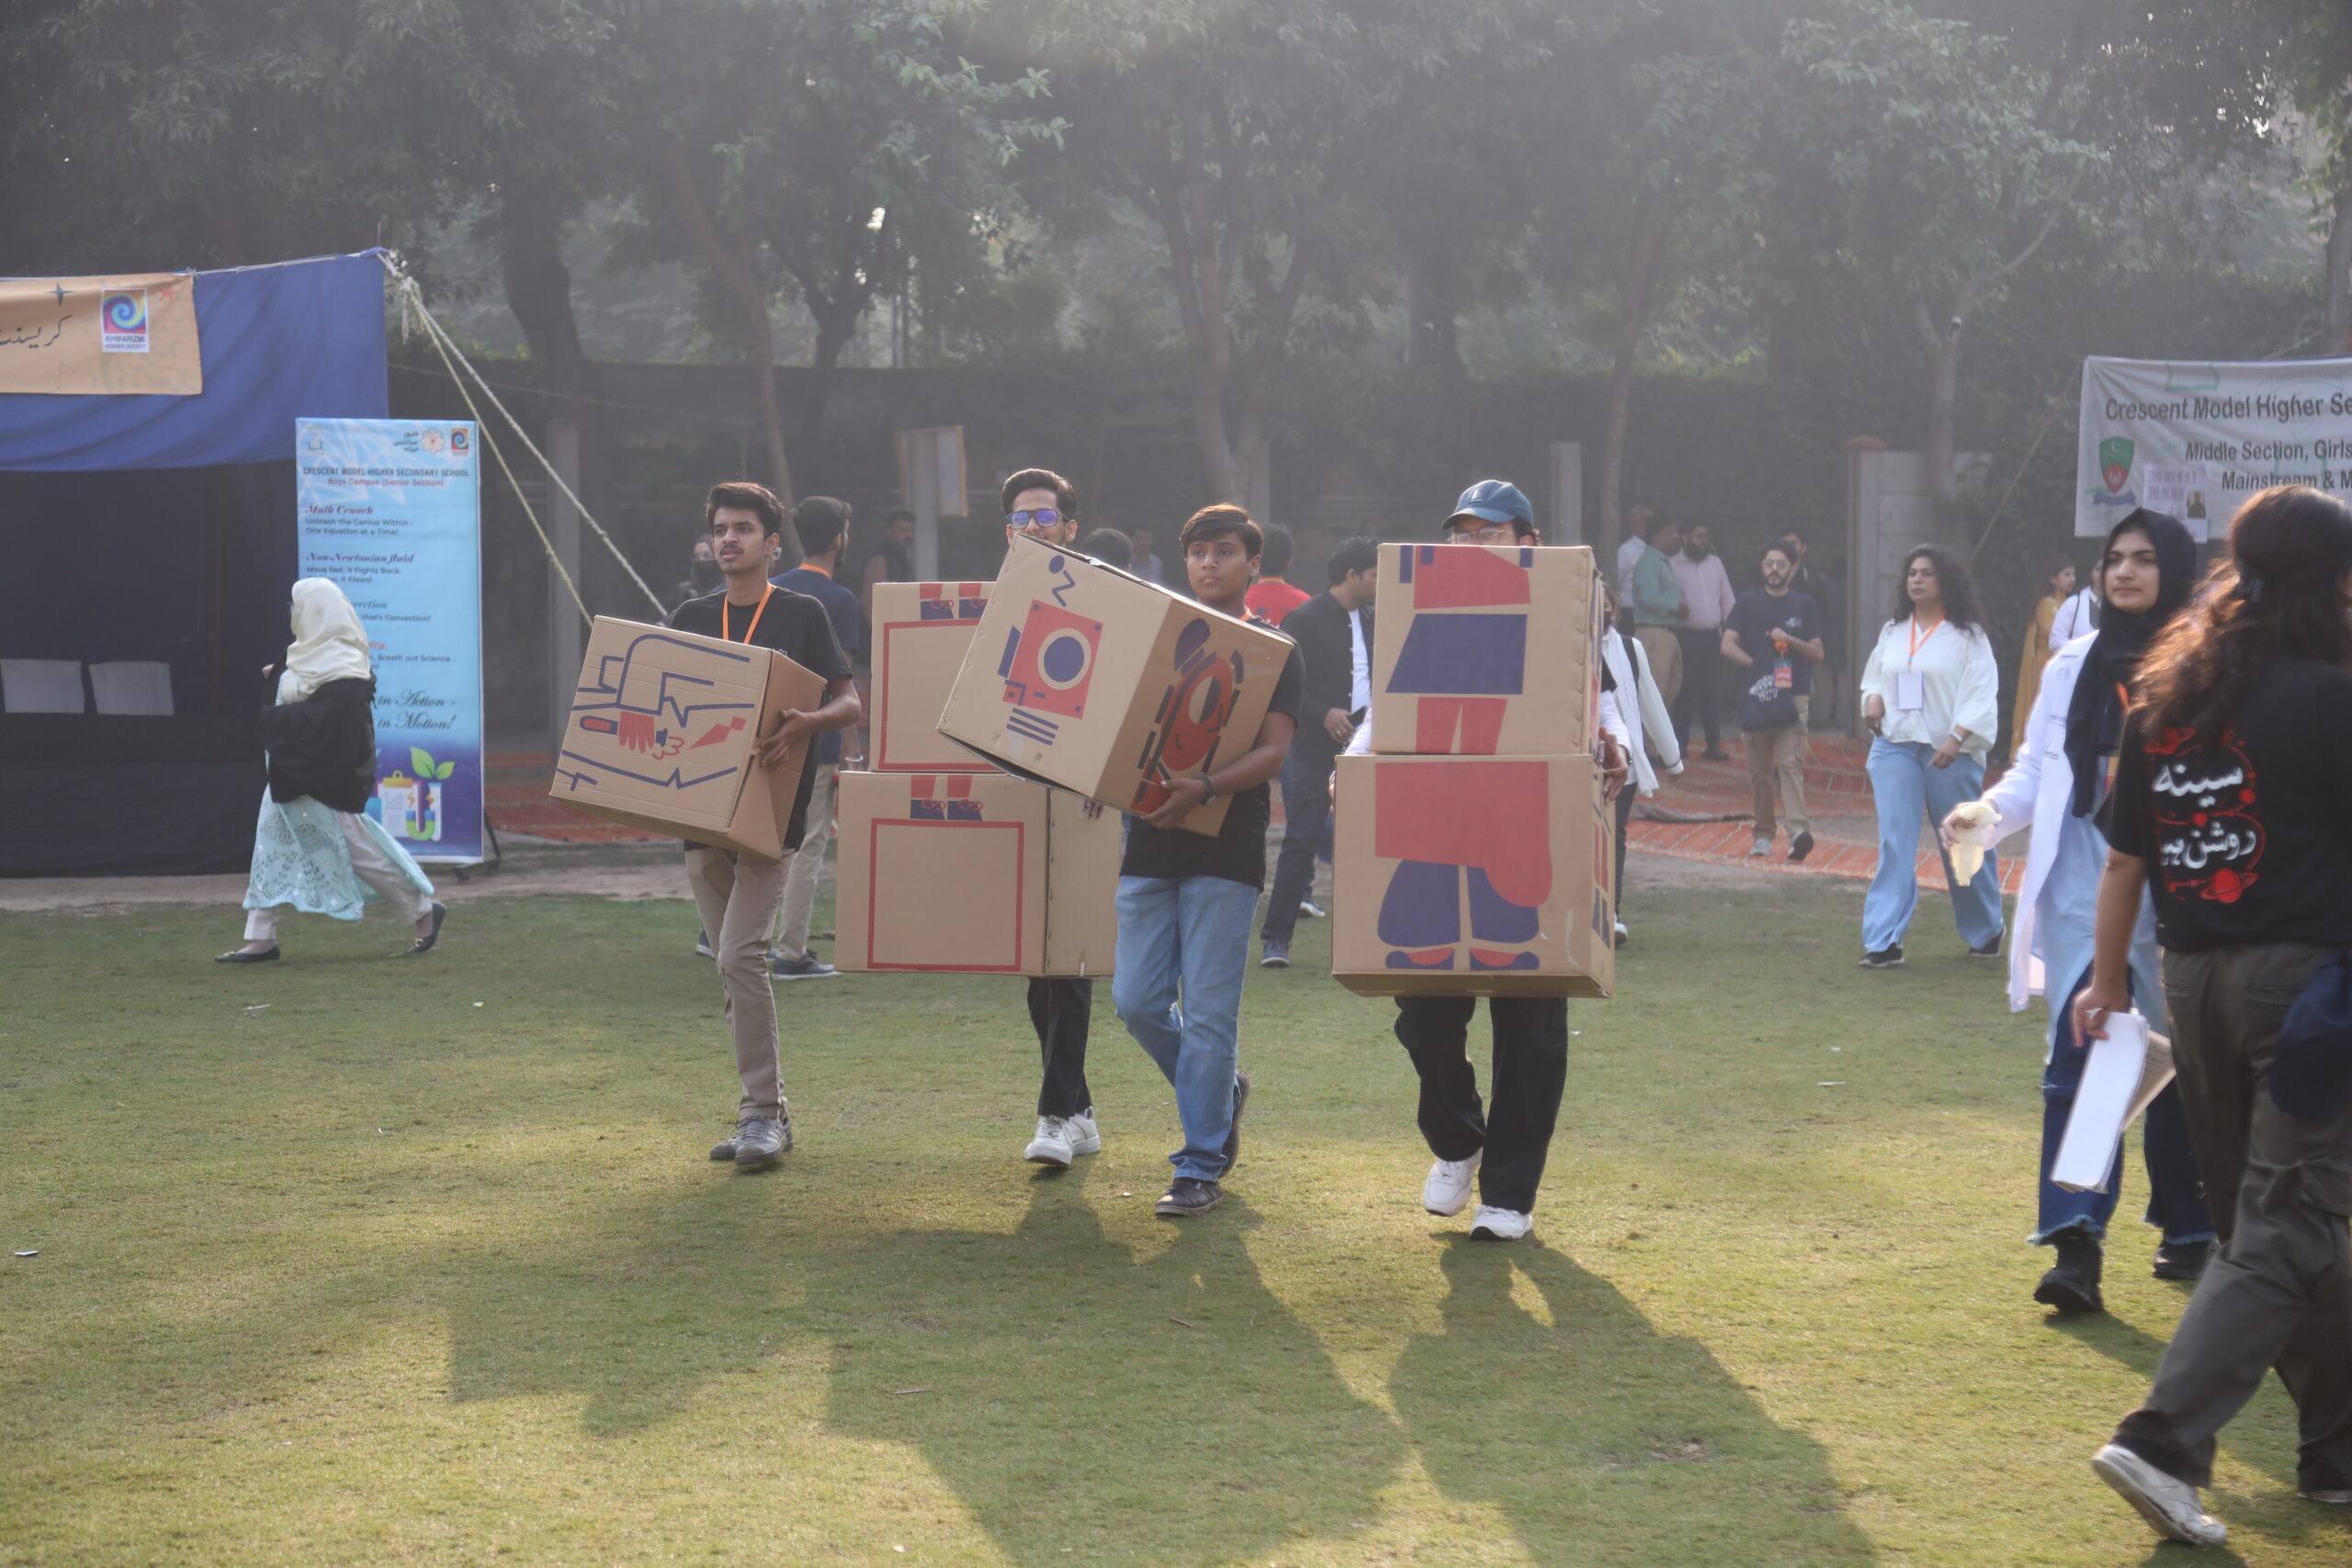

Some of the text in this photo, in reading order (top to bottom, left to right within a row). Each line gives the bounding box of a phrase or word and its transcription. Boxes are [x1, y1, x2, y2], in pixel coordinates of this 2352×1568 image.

[2106, 398, 2188, 421] Crescent
[2194, 396, 2251, 419] Model
[2256, 395, 2324, 423] Higher
[2186, 441, 2237, 460] Middle
[2242, 440, 2308, 462] Section,
[303, 467, 339, 475] CRESCENT
[341, 468, 366, 476] MODEL
[396, 468, 439, 477] SECONDARY
[441, 469, 469, 478] SCHOOL
[2222, 470, 2317, 491] Mainstream
[2323, 470, 2335, 490] &
[327, 478, 345, 487] Boys
[348, 478, 379, 487] Campus
[305, 505, 373, 514] Math Crunch
[323, 527, 358, 536] Equation
[305, 553, 414, 564] Non-Newtonian fluid
[421, 654, 450, 662] Science
[378, 694, 390, 705] in
[395, 689, 446, 707] Action
[377, 711, 456, 729] in Motion!
[2152, 763, 2243, 808] سینہ
[2182, 821, 2256, 869] روشن
